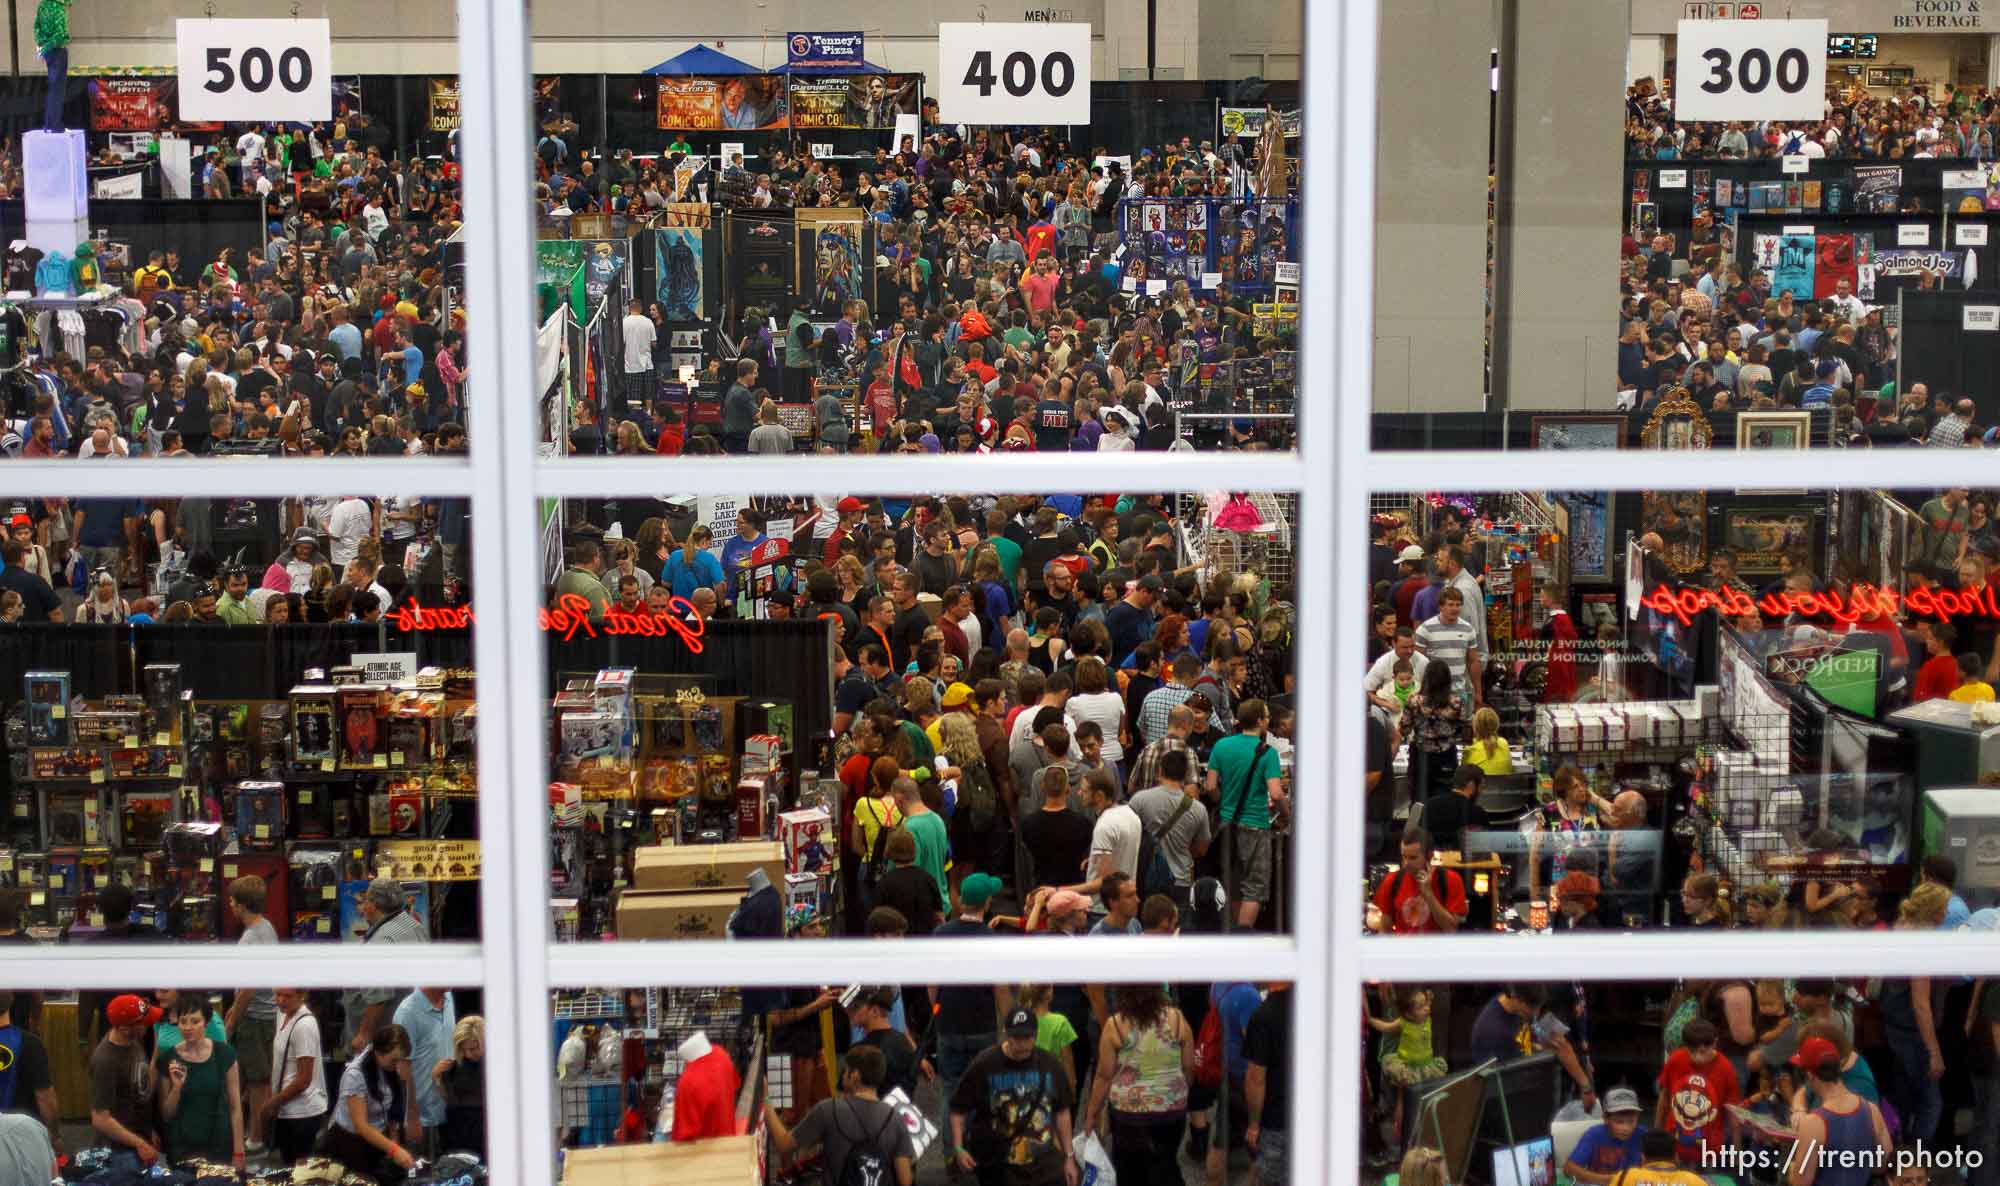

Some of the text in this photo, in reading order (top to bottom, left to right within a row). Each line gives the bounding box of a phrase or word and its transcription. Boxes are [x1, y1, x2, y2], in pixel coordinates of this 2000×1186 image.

[1915, 0, 1961, 12] FOOD
[1024, 10, 1050, 22] MEN
[1894, 16, 1981, 27] BEVERAGE
[812, 35, 862, 46] Tenney's
[822, 46, 854, 55] Pizza
[203, 47, 313, 94] 500
[962, 50, 1075, 97] 400
[1700, 47, 1810, 94] 300
[661, 115, 714, 129] COMIC CON
[793, 113, 825, 126] COMIC
[1932, 253, 1955, 272] Joy
[715, 501, 736, 511] SALT
[714, 510, 737, 520] LAKE
[366, 662, 402, 671] ATOMIC AGE
